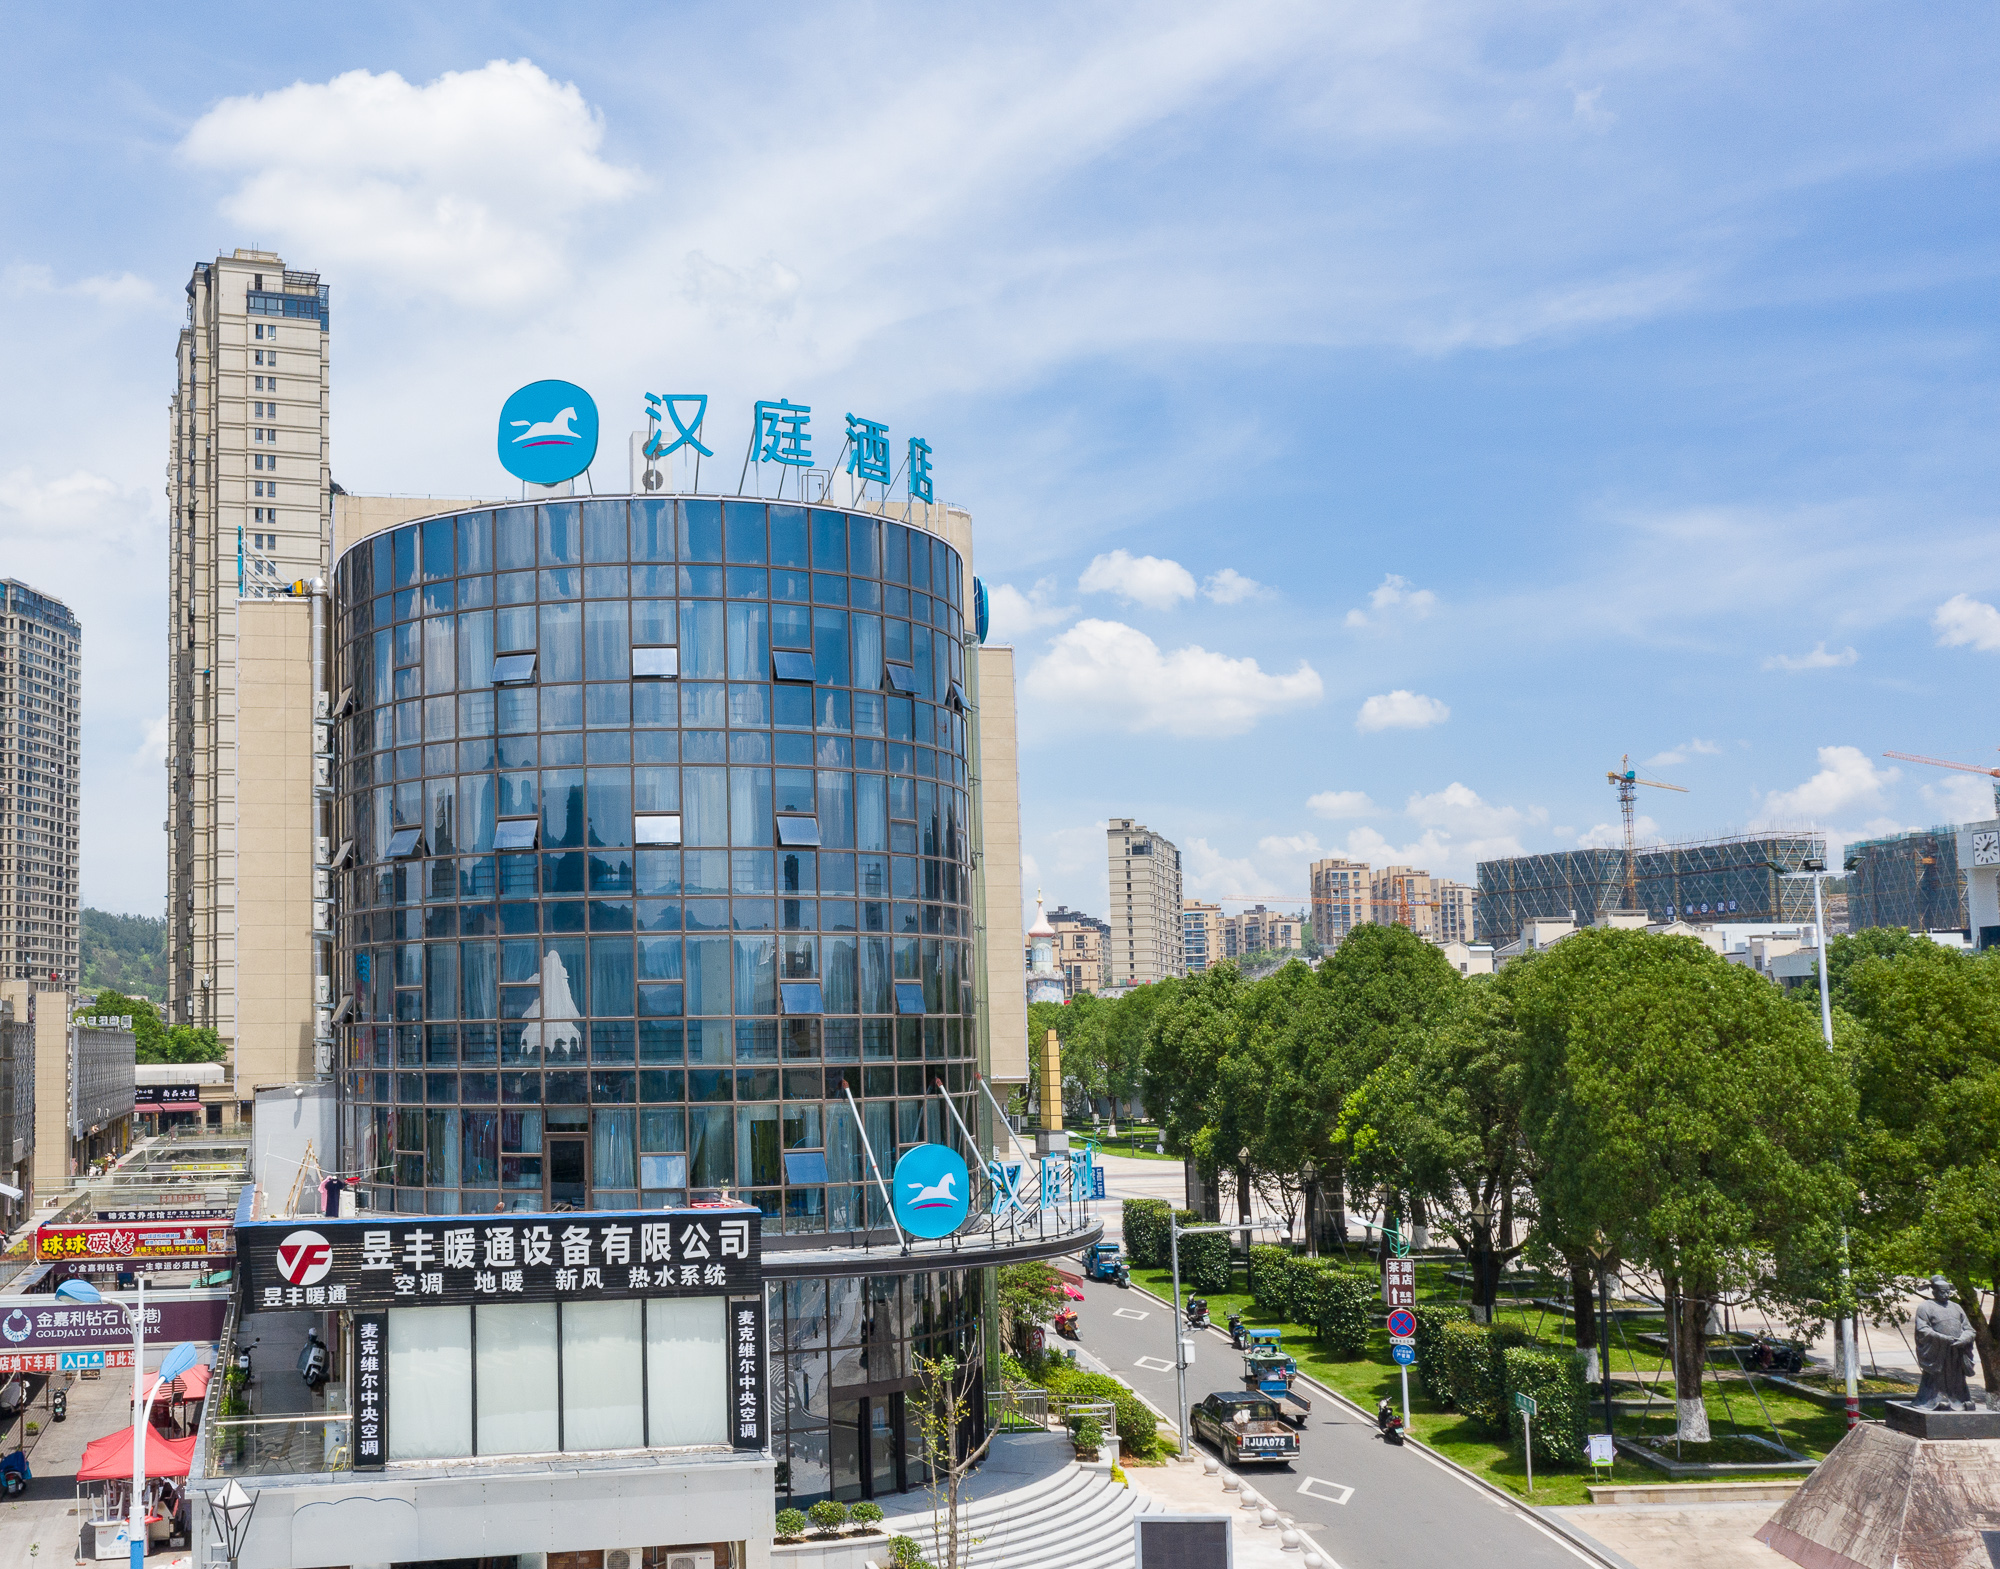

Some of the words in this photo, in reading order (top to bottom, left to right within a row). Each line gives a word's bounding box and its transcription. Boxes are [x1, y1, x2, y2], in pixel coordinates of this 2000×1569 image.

[645, 391, 933, 505] 汉庭酒店
[988, 1143, 1093, 1215] 汉庭酒
[361, 1219, 749, 1271] 昱丰暖通设备有限公司
[78, 1263, 124, 1273] 金嘉利钻石
[136, 1261, 209, 1271] 一生幸运必须是你
[394, 1273, 443, 1296] 空调
[474, 1270, 524, 1294] 地暖
[555, 1267, 604, 1291] 新风
[628, 1263, 727, 1289] 热水系统
[1389, 1262, 1412, 1272] 茶源
[1390, 1274, 1412, 1285] 酒店
[263, 1285, 347, 1308] 昱丰暖通
[36, 1329, 87, 1338] GOLDJALY
[90, 1327, 138, 1336] DIAMON
[65, 1354, 88, 1369] 入口
[737, 1310, 757, 1440] 麦克维尔中央空调
[360, 1323, 379, 1457] 麦克维尔中央空调
